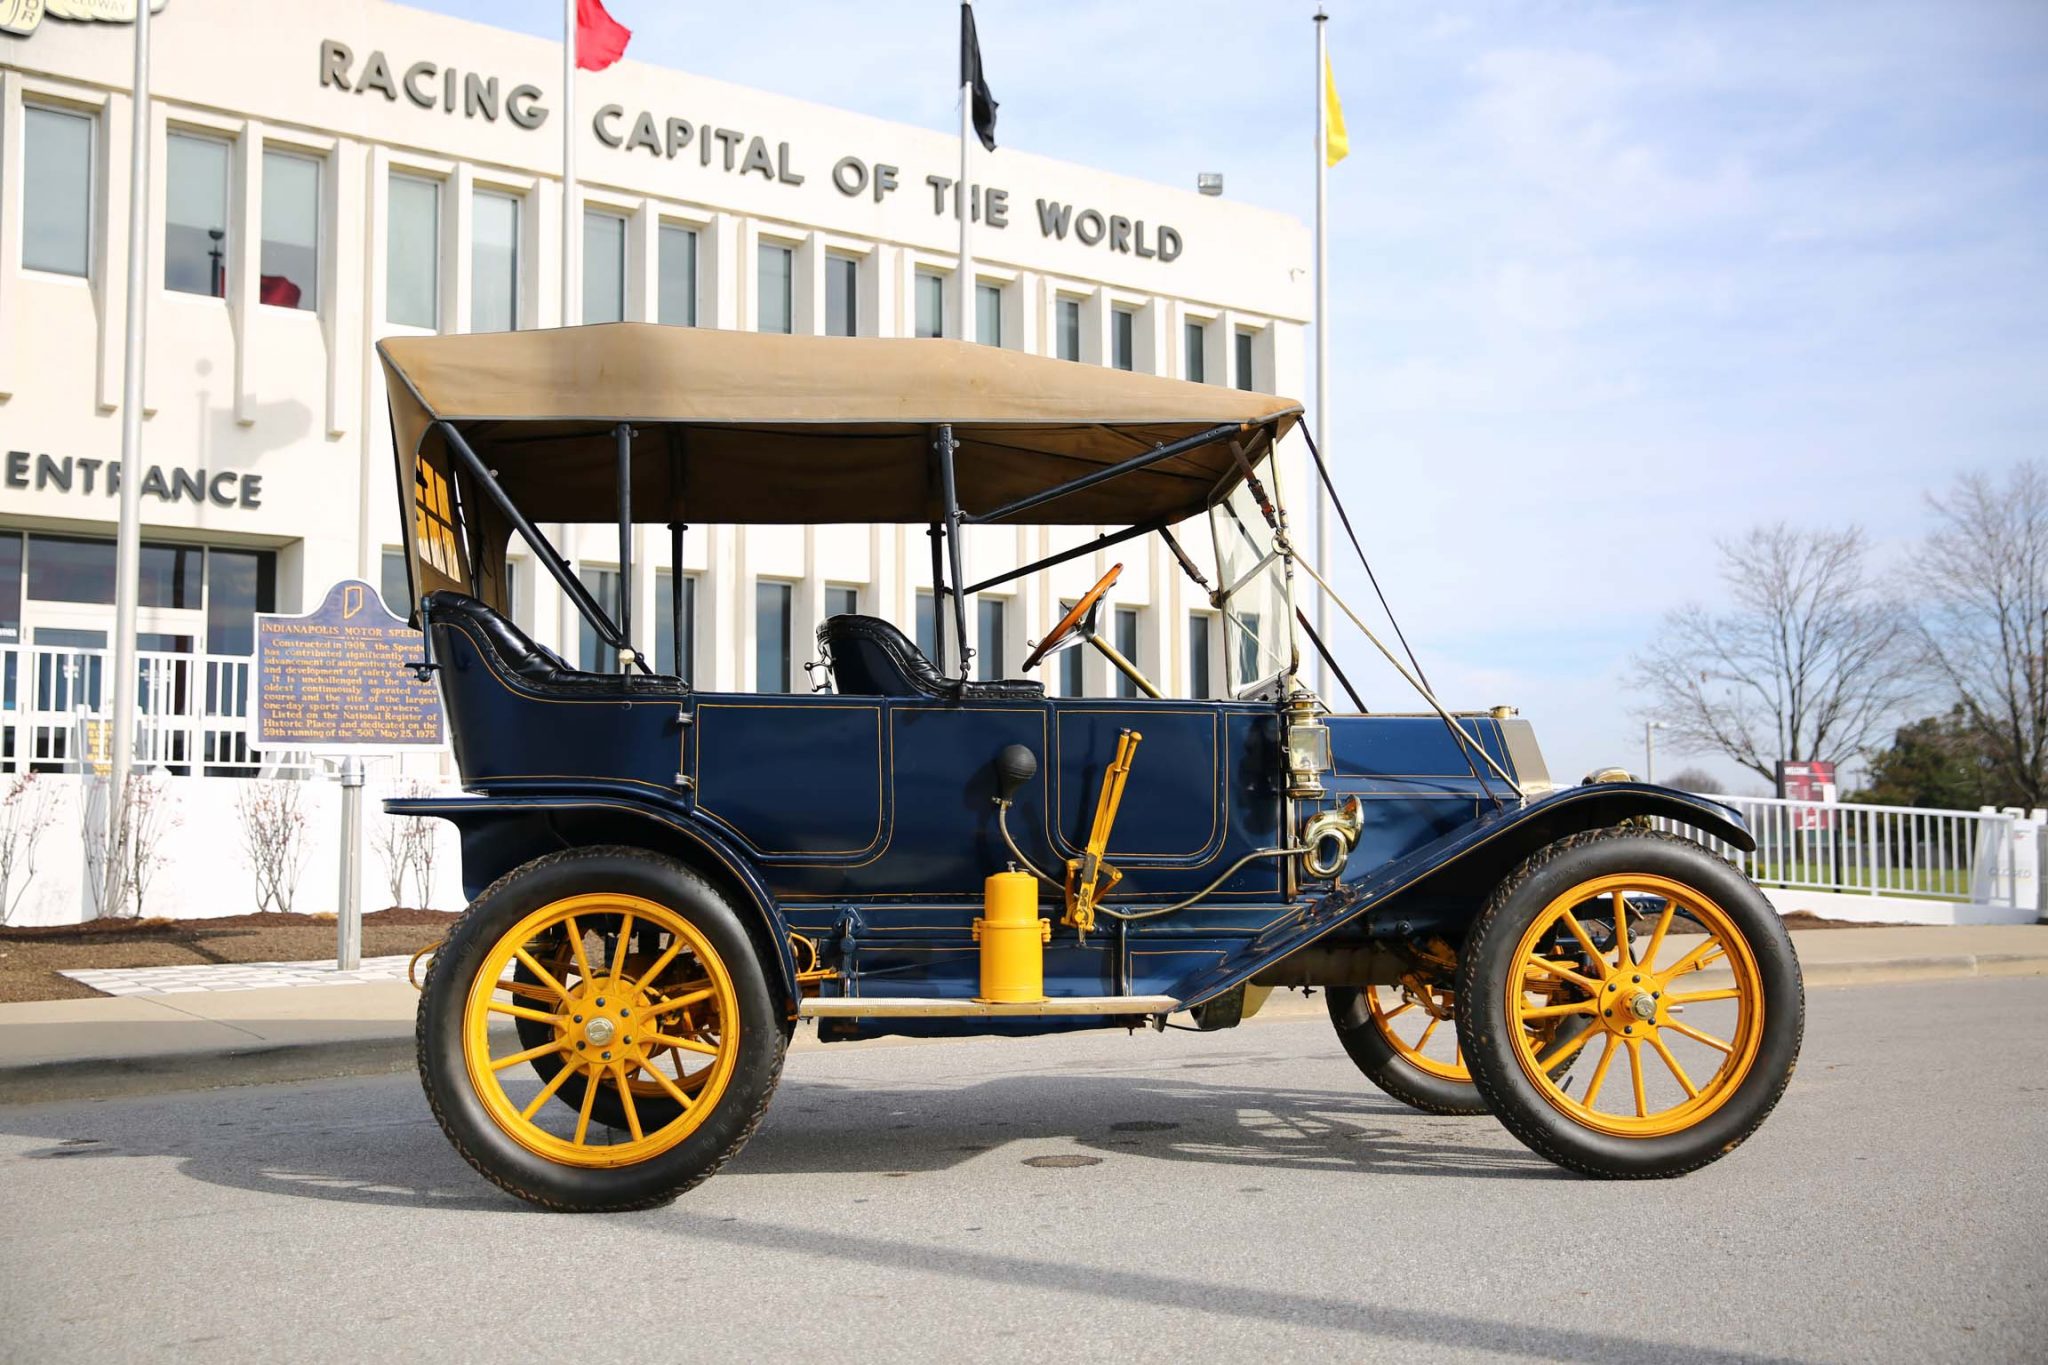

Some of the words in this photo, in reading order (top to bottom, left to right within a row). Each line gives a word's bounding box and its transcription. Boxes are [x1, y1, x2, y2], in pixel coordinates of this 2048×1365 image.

[319, 38, 549, 129] RACING
[592, 103, 804, 186] CAPITAL
[833, 156, 899, 202] OF
[926, 175, 1009, 229] THE
[1036, 198, 1183, 262] WORLD
[262, 624, 339, 635] INDIANAPOLIS
[345, 627, 382, 637] MOTOR
[273, 640, 331, 649] Constructed
[333, 641, 342, 649] in
[264, 649, 280, 657] has
[286, 649, 341, 658] contributed
[347, 650, 403, 661] significantly
[264, 658, 323, 666] advancement
[326, 659, 335, 667] of
[337, 660, 384, 668] automotive
[264, 667, 281, 675] and
[286, 668, 343, 677] development
[348, 668, 358, 676] of
[363, 668, 391, 678] safety
[302, 676, 362, 687] unchallenged
[385, 678, 399, 686] the
[264, 684, 293, 692] oldest
[302, 686, 362, 695] continuously
[371, 687, 410, 696] operated
[302, 693, 319, 701] and
[326, 694, 341, 702] the
[369, 695, 379, 703] of
[406, 696, 437, 705] largest
[264, 702, 304, 712] one-day
[310, 703, 339, 712] sports
[272, 711, 301, 719] Listed
[344, 712, 382, 721] National
[385, 713, 421, 723] Register
[264, 719, 302, 728] Historic
[307, 720, 336, 728] Places
[341, 720, 357, 728] and
[361, 721, 404, 729] dedicated
[424, 722, 437, 730] the
[264, 728, 286, 736] 59th
[288, 729, 326, 738] running
[326, 729, 335, 737] of
[338, 729, 352, 737] the
[381, 730, 397, 738] May
